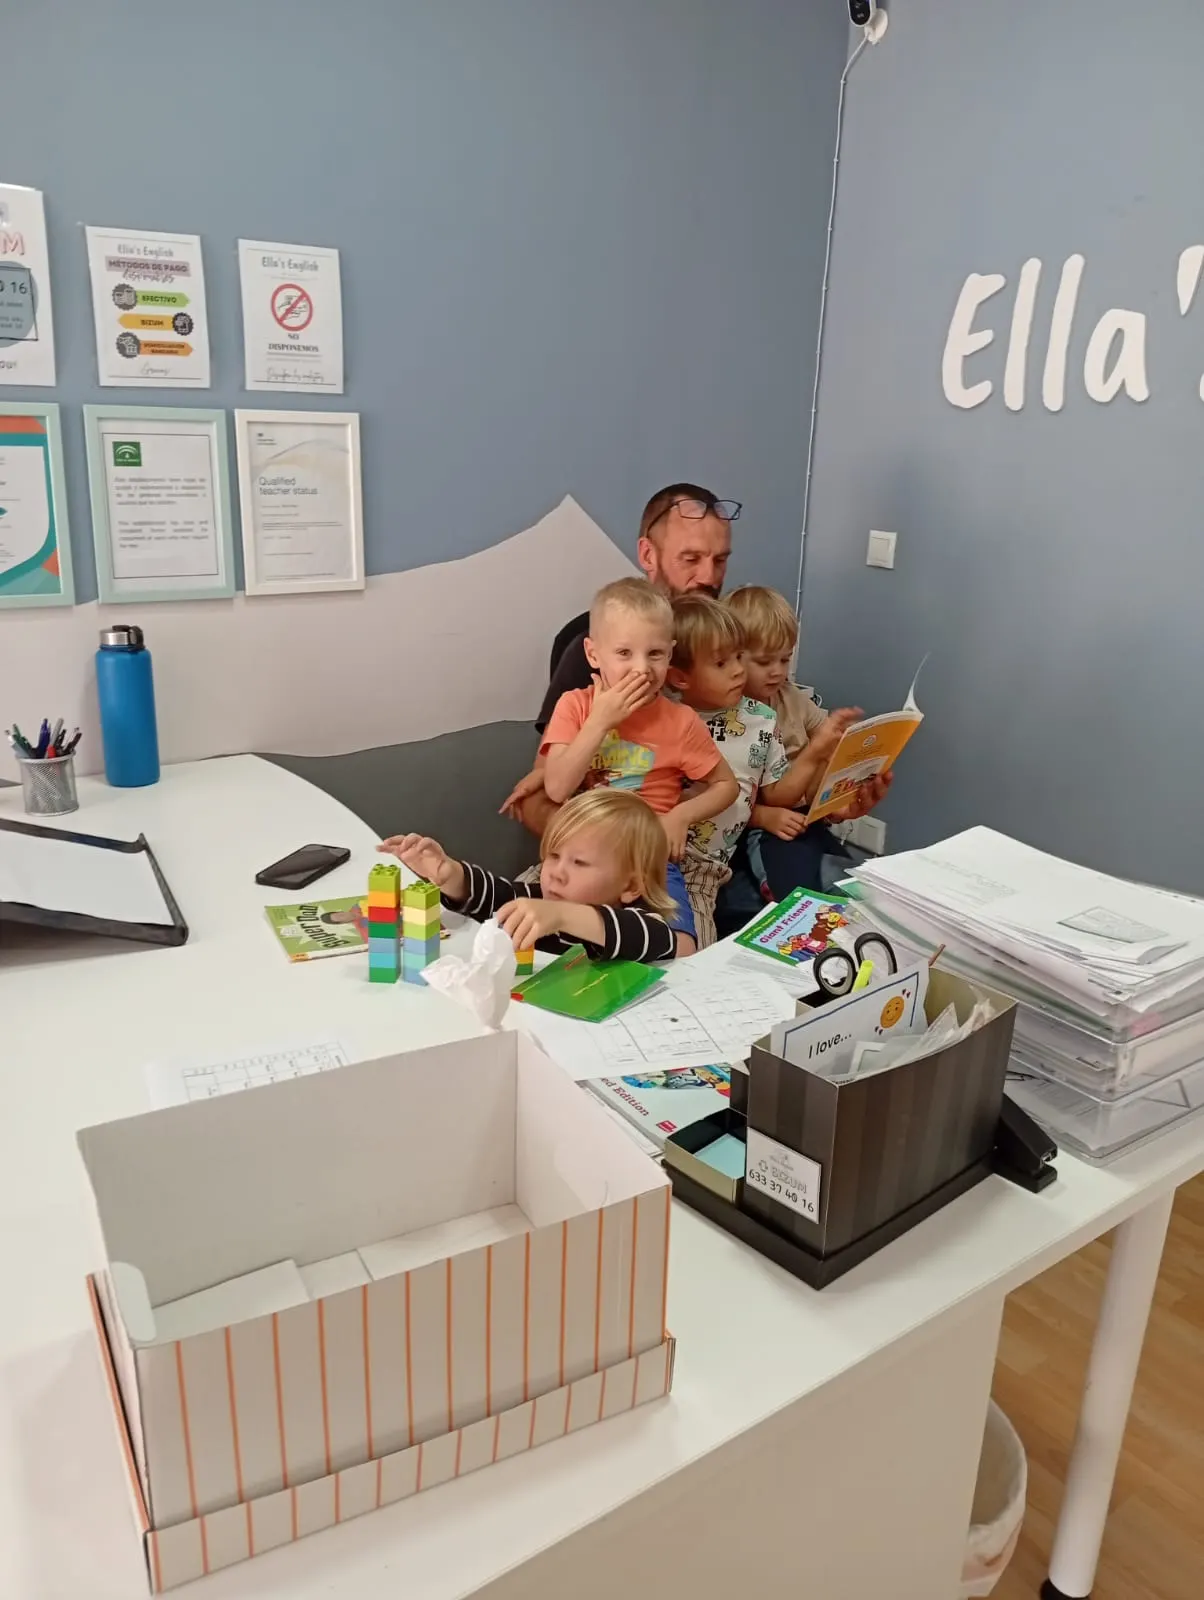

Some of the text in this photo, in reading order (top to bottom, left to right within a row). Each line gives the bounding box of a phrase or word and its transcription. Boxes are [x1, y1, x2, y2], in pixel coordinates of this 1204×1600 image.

[11, 281, 27, 295] 16
[141, 295, 177, 304] EFECTIVO
[942, 245, 1204, 411] Ella'
[268, 343, 320, 353] DISPONEMOS
[258, 476, 297, 487] Qualified
[259, 486, 319, 496] teacher status
[760, 925, 784, 944] Giant
[782, 900, 813, 926] Friends
[300, 923, 351, 948] Super
[808, 1044, 813, 1060] I
[613, 1086, 650, 1117] Edition
[749, 1168, 814, 1213] 633 37 40 16
